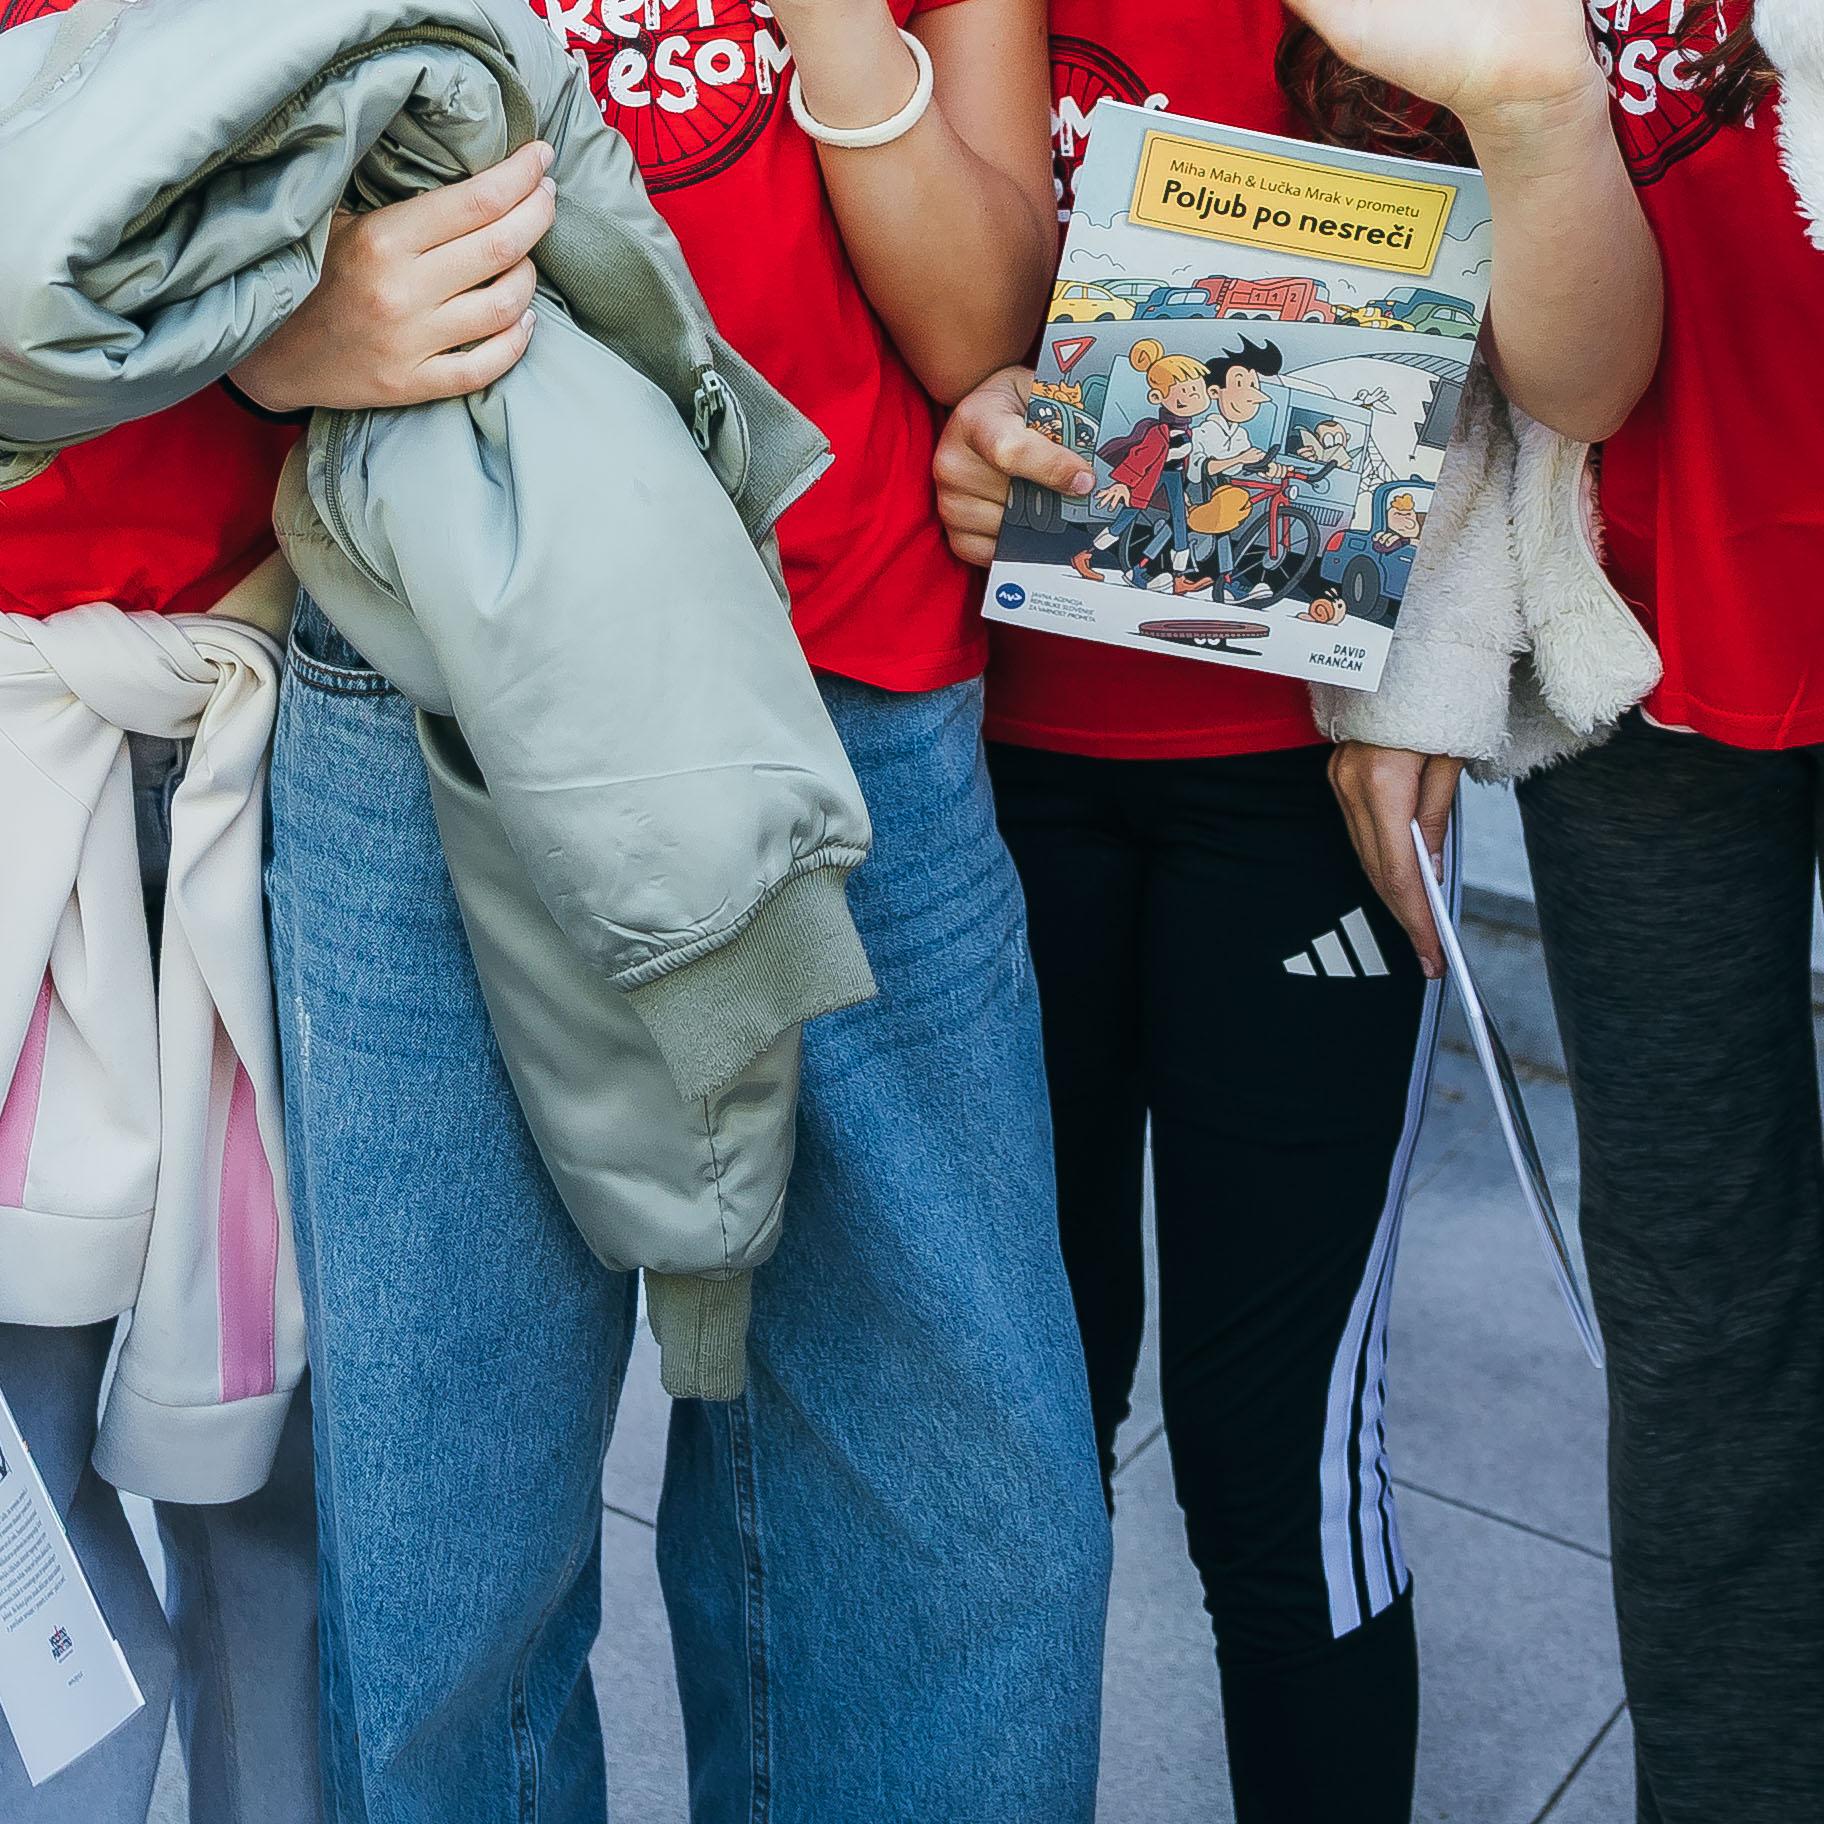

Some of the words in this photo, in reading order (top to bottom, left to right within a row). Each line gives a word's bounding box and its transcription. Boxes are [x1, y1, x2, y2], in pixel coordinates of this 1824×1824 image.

[1169, 159, 1206, 178] Miha
[1209, 167, 1241, 185] Mah
[1245, 175, 1257, 188] &
[1259, 177, 1301, 197] Lučka
[1305, 187, 1342, 204] Mrak
[1345, 197, 1354, 207] v
[1355, 197, 1421, 219] prometu
[1161, 179, 1247, 220] Poljub
[1252, 206, 1291, 231] po
[1298, 214, 1415, 250] nesreči
[1308, 652, 1363, 672] KRANČAN
[1333, 644, 1366, 659] DAVID
